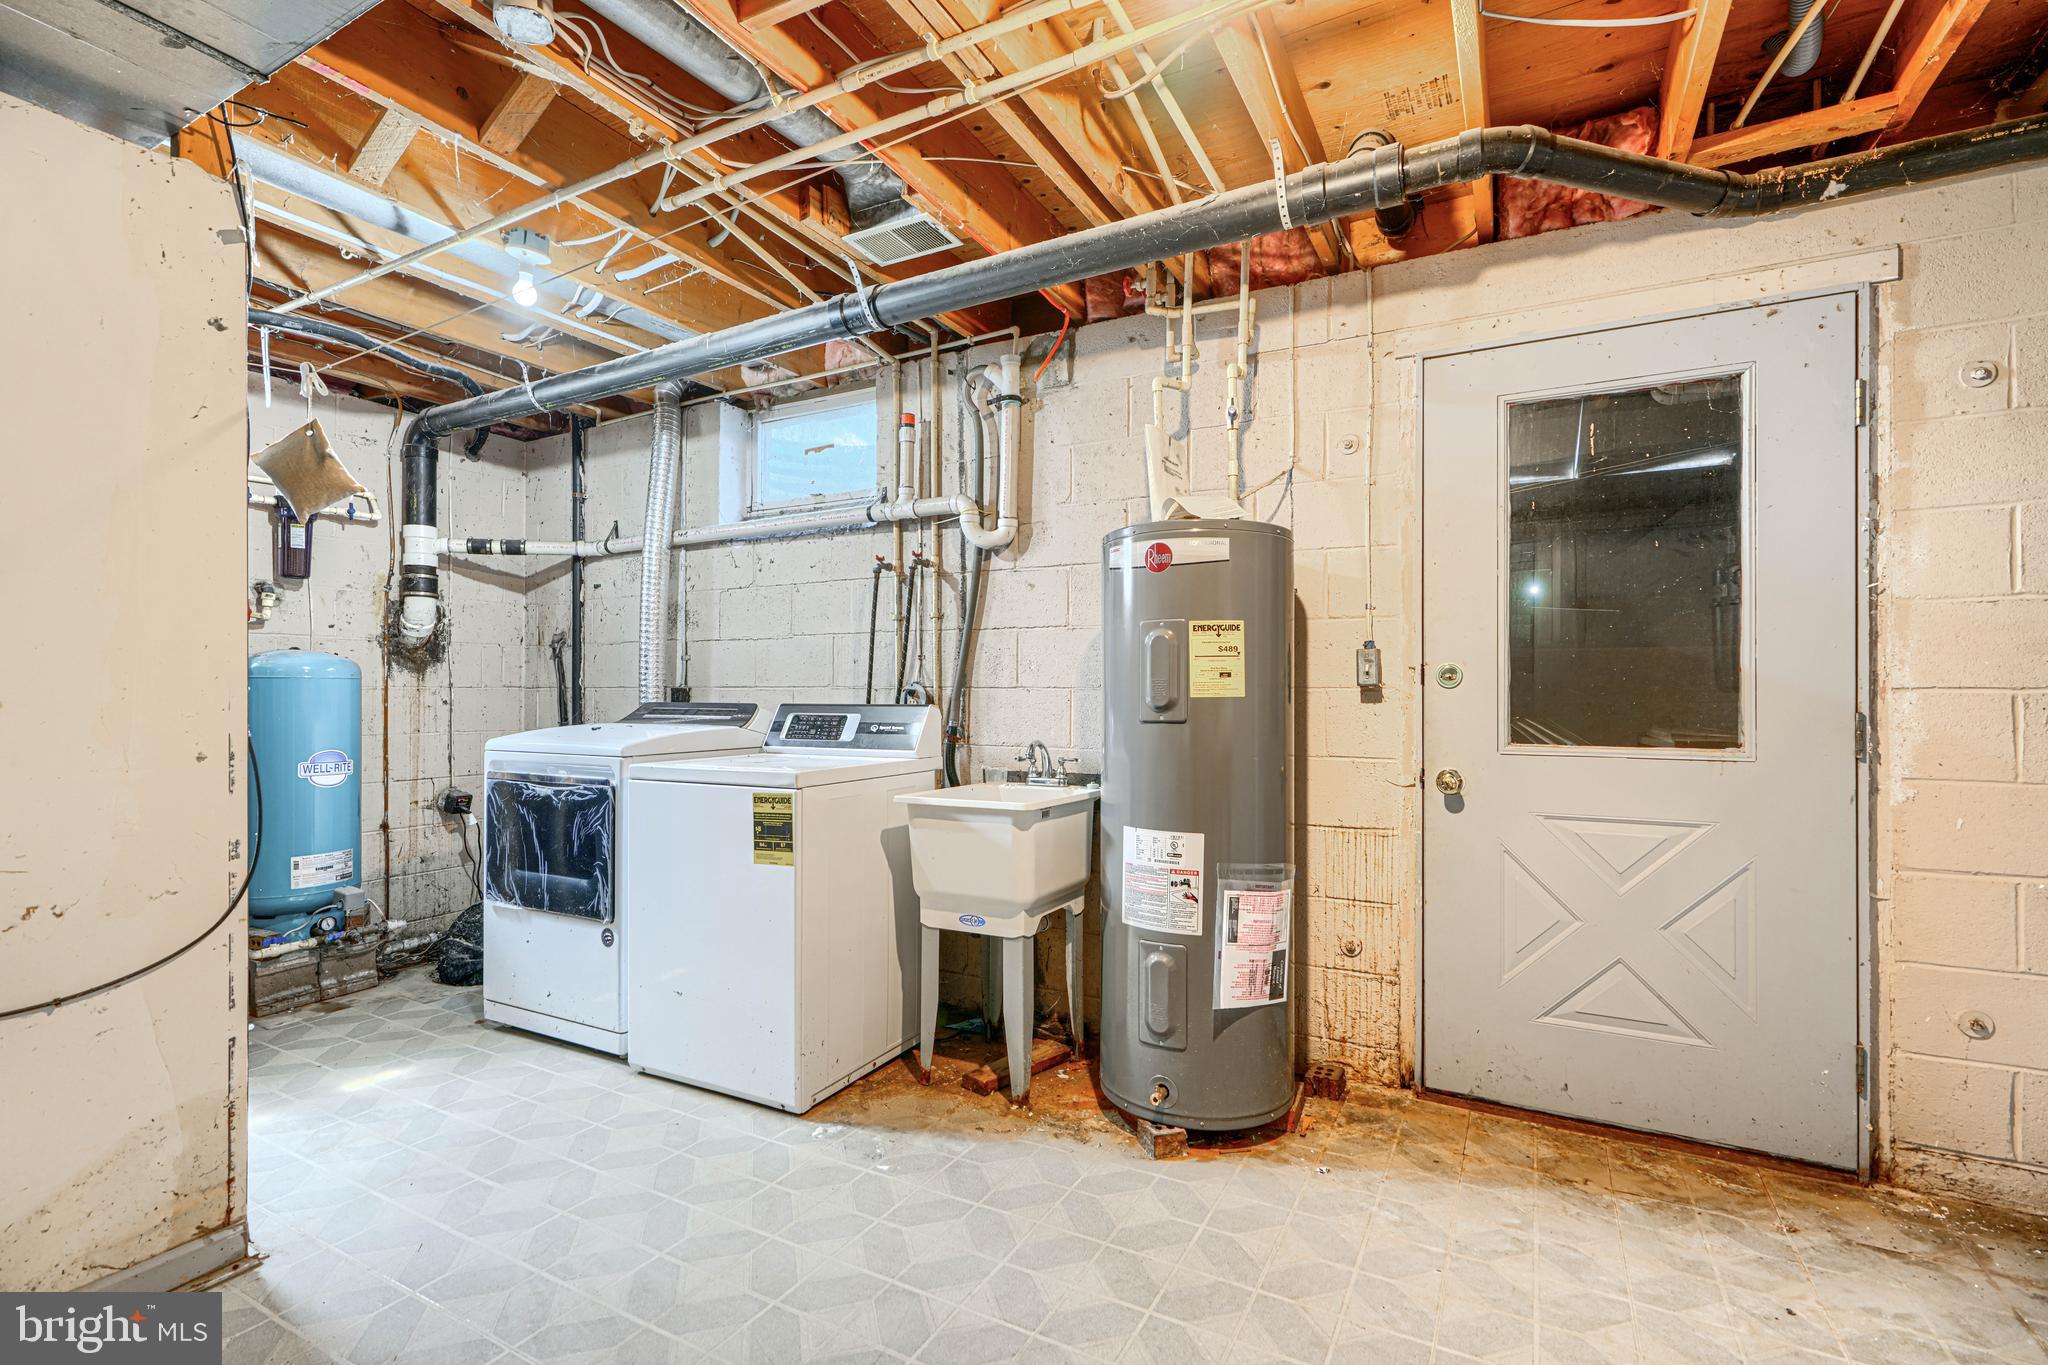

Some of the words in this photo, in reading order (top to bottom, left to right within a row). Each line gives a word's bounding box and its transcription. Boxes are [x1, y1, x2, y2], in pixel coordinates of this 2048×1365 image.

[1147, 543, 1171, 568] Rheem
[1192, 624, 1241, 633] ENERGYGUIDE
[1218, 645, 1239, 653] $489
[302, 762, 352, 774] WELL-RITE
